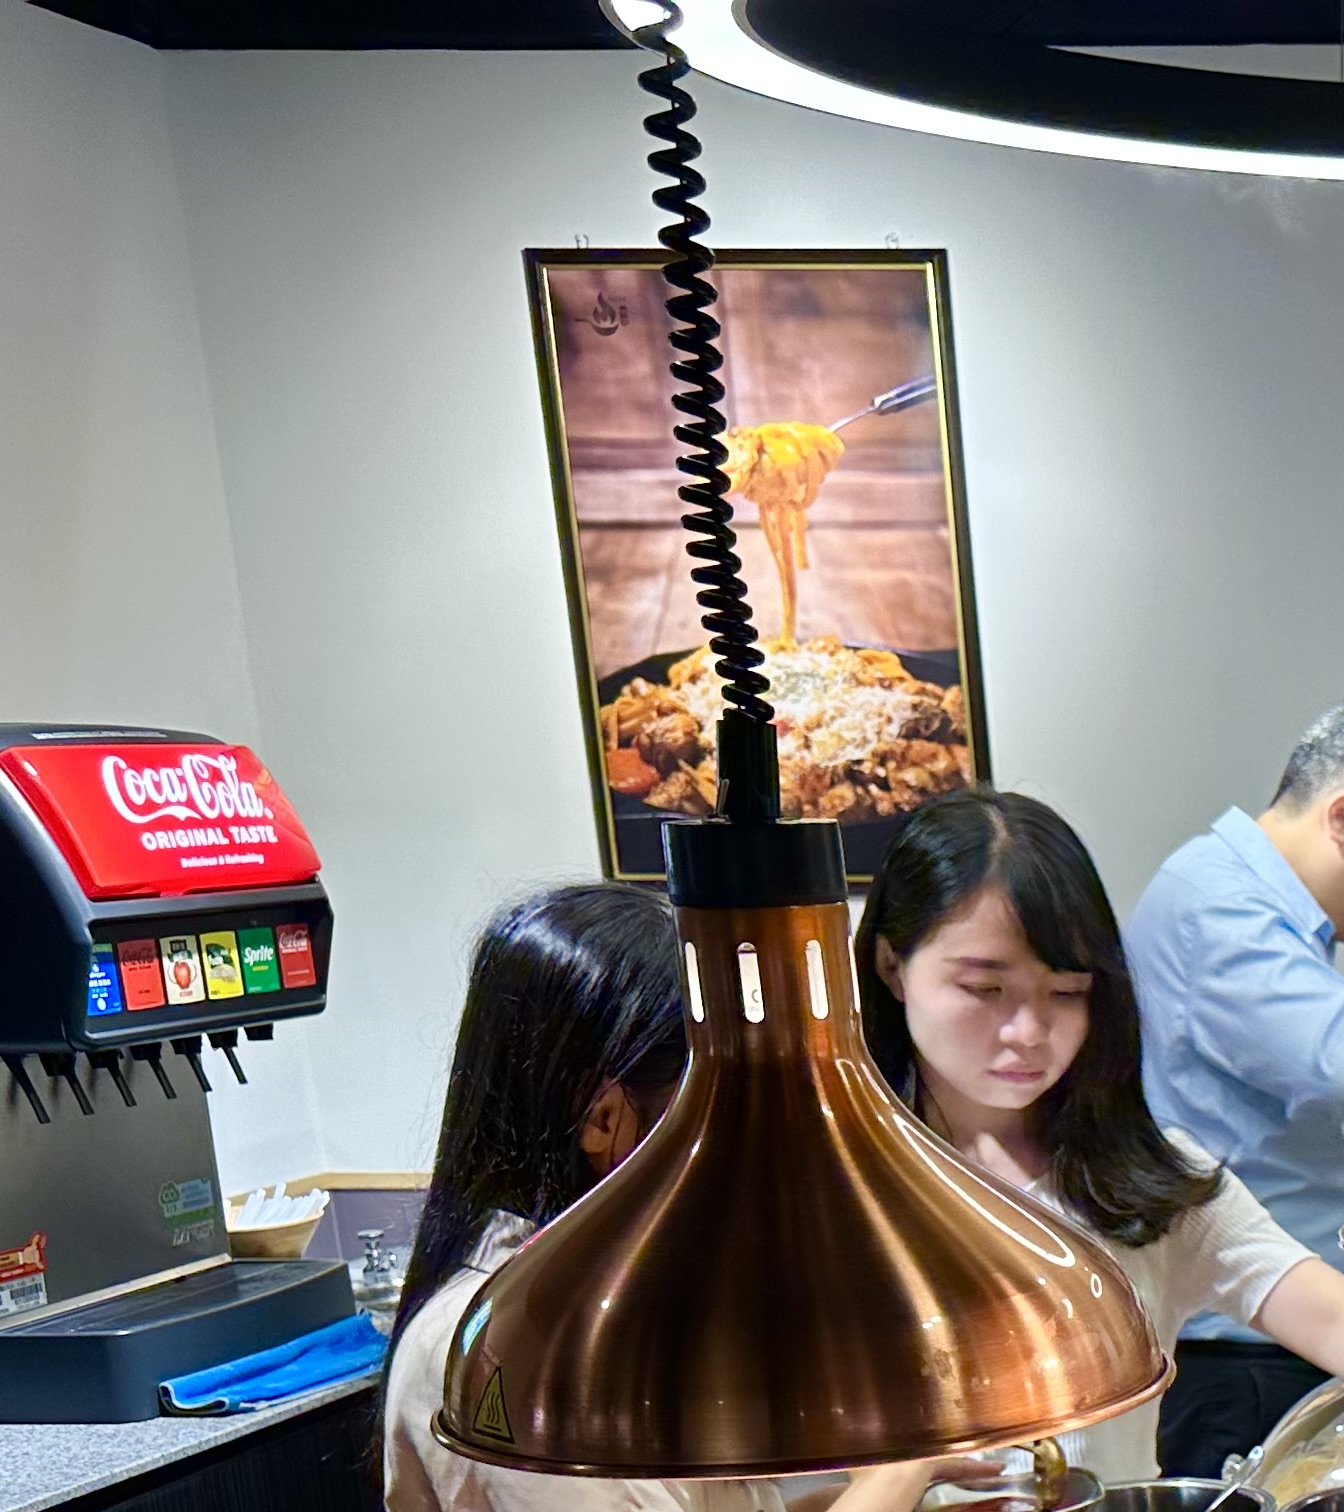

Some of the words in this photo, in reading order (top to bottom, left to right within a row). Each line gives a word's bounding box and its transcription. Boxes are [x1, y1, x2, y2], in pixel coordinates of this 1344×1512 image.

[102, 754, 264, 824] Coca-Cola
[141, 828, 229, 850] ORIGINAL
[229, 825, 278, 844] TASTE
[244, 945, 274, 966] Sprite
